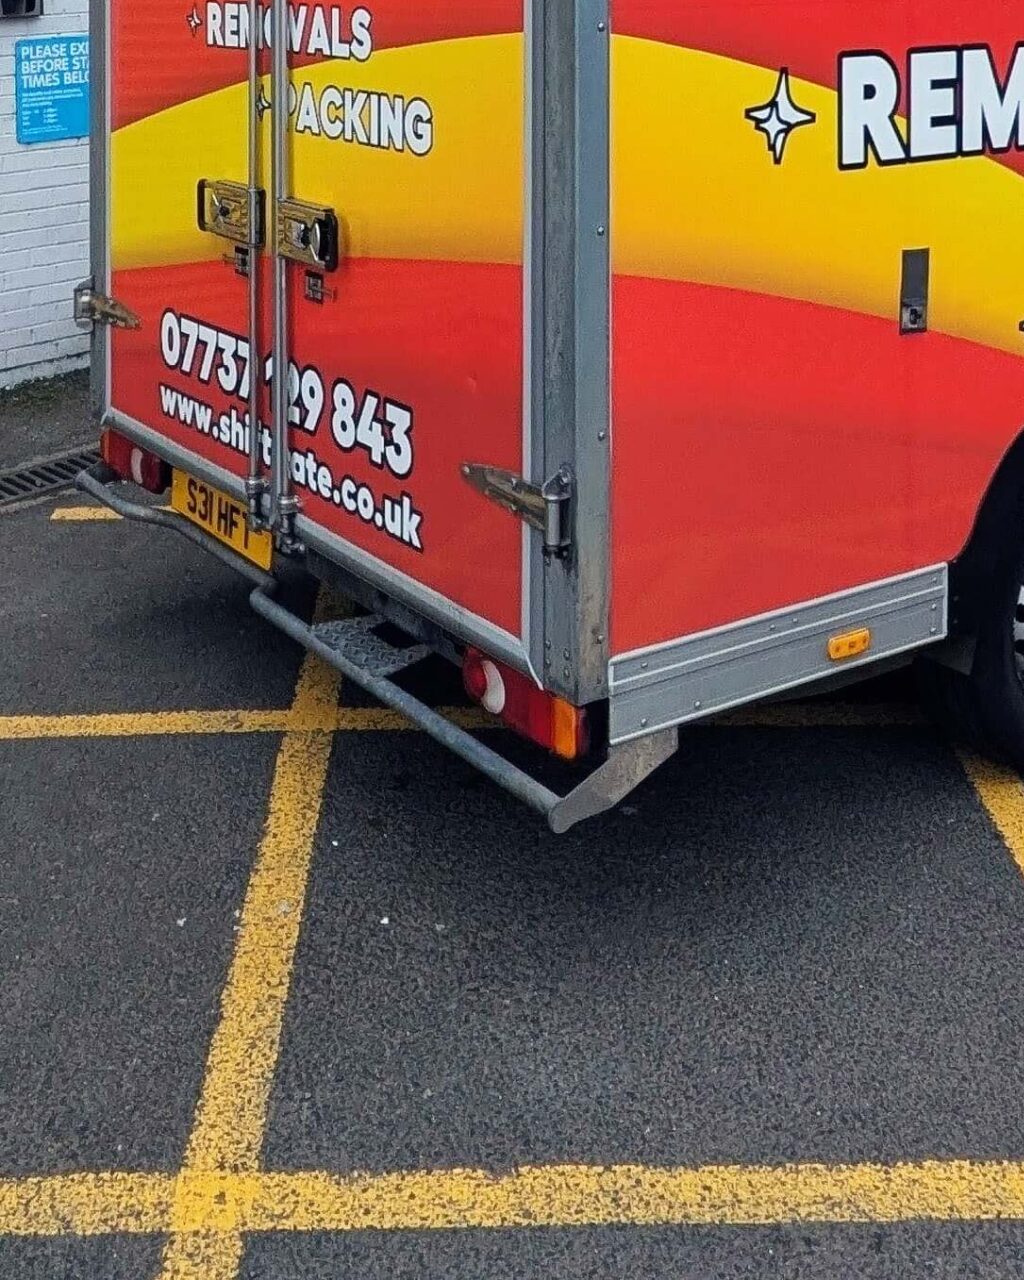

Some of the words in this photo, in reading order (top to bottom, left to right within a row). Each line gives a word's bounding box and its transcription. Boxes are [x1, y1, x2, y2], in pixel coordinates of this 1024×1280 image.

[21, 43, 67, 60] PLEASE
[21, 57, 69, 75] BEFORE
[72, 56, 89, 70] ST
[21, 72, 60, 89] TIMES
[331, 377, 415, 480] 843
[187, 477, 214, 526] S31
